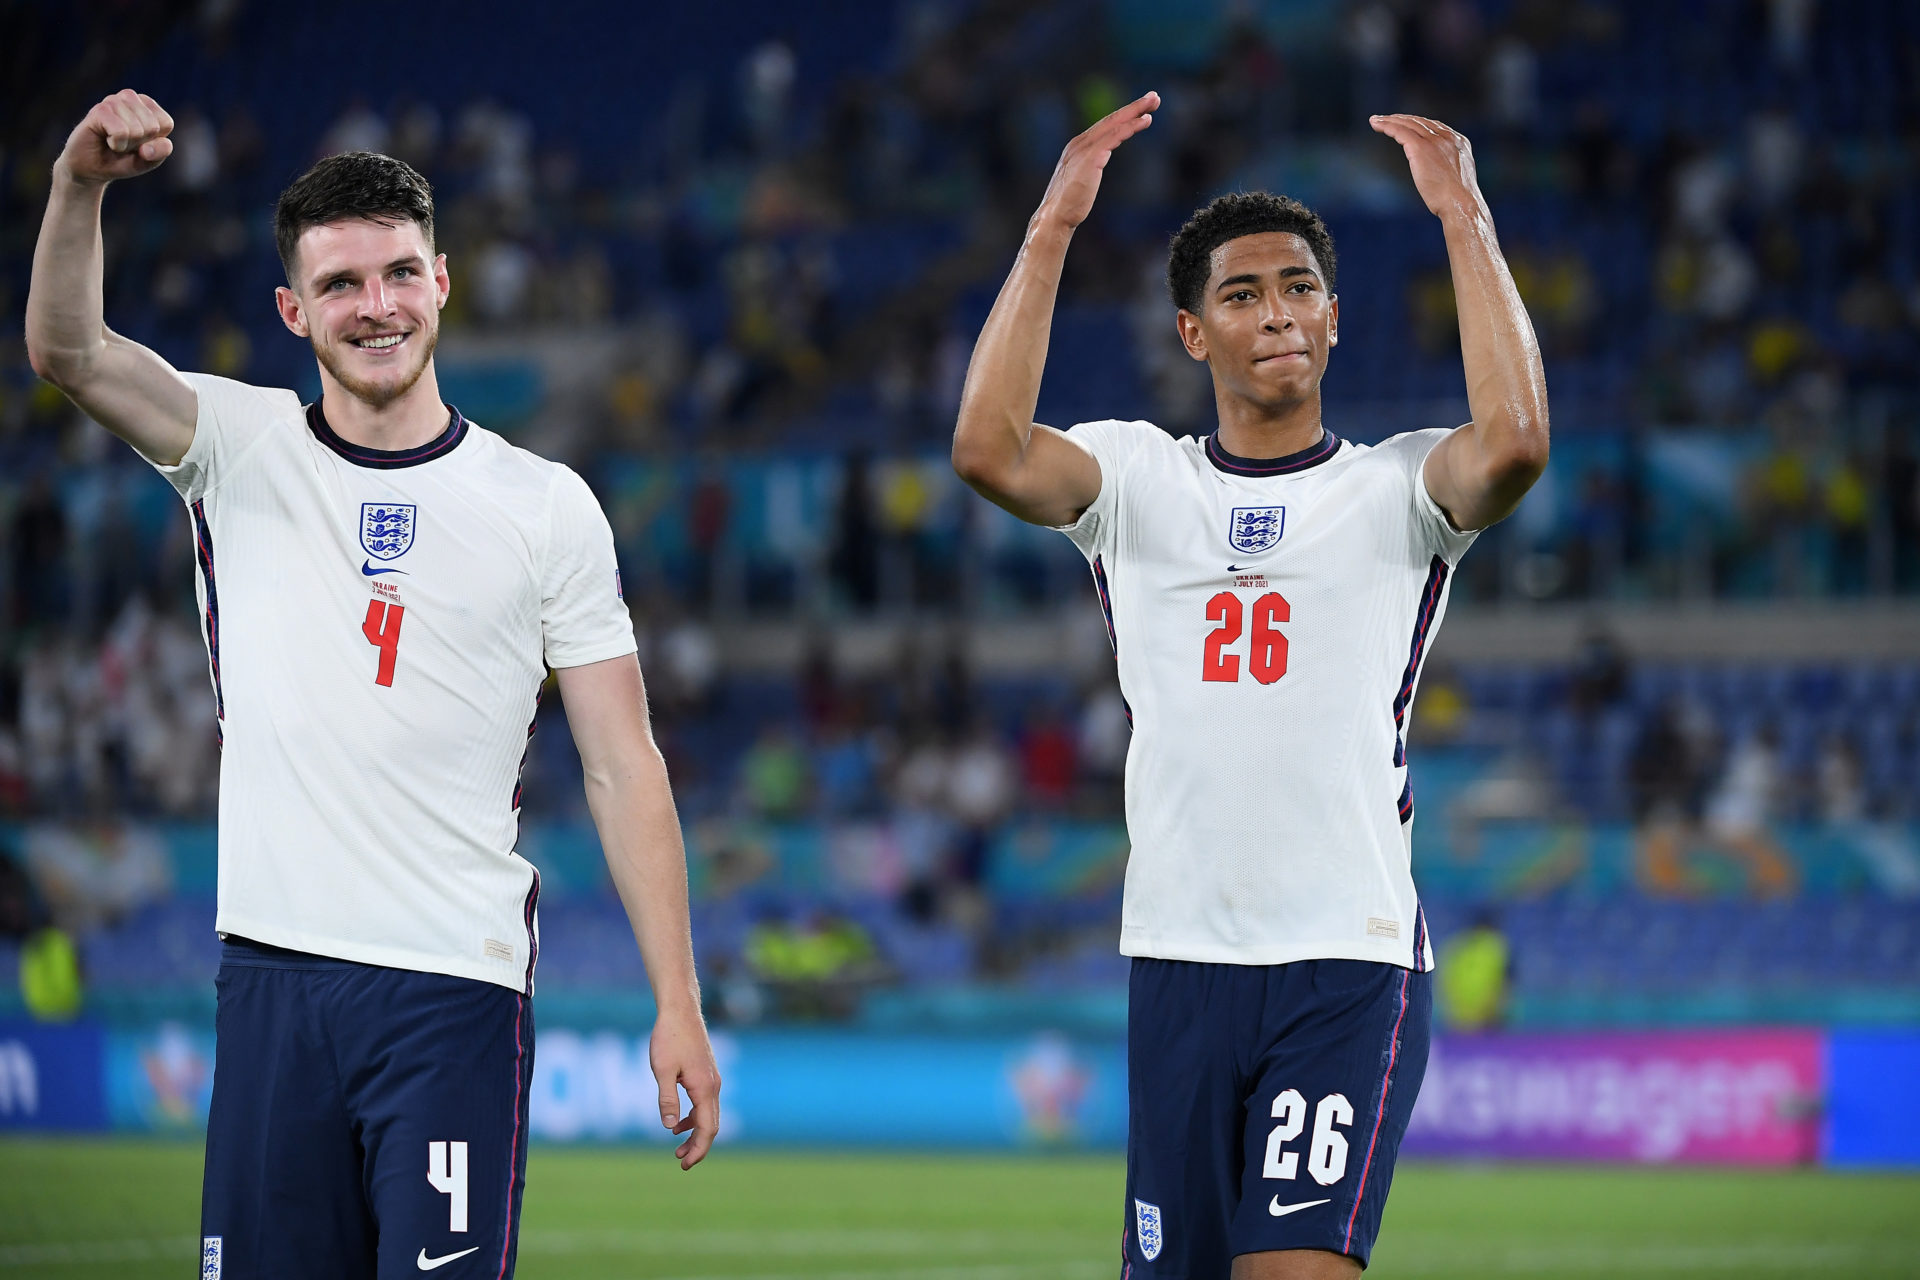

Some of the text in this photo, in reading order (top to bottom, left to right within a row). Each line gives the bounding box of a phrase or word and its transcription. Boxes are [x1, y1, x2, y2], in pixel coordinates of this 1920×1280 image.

[371, 580, 399, 592] UKRAINE
[362, 599, 405, 687] 4
[1202, 591, 1290, 685] 26
[1262, 1088, 1354, 1186] 26
[427, 1141, 468, 1232] 4
